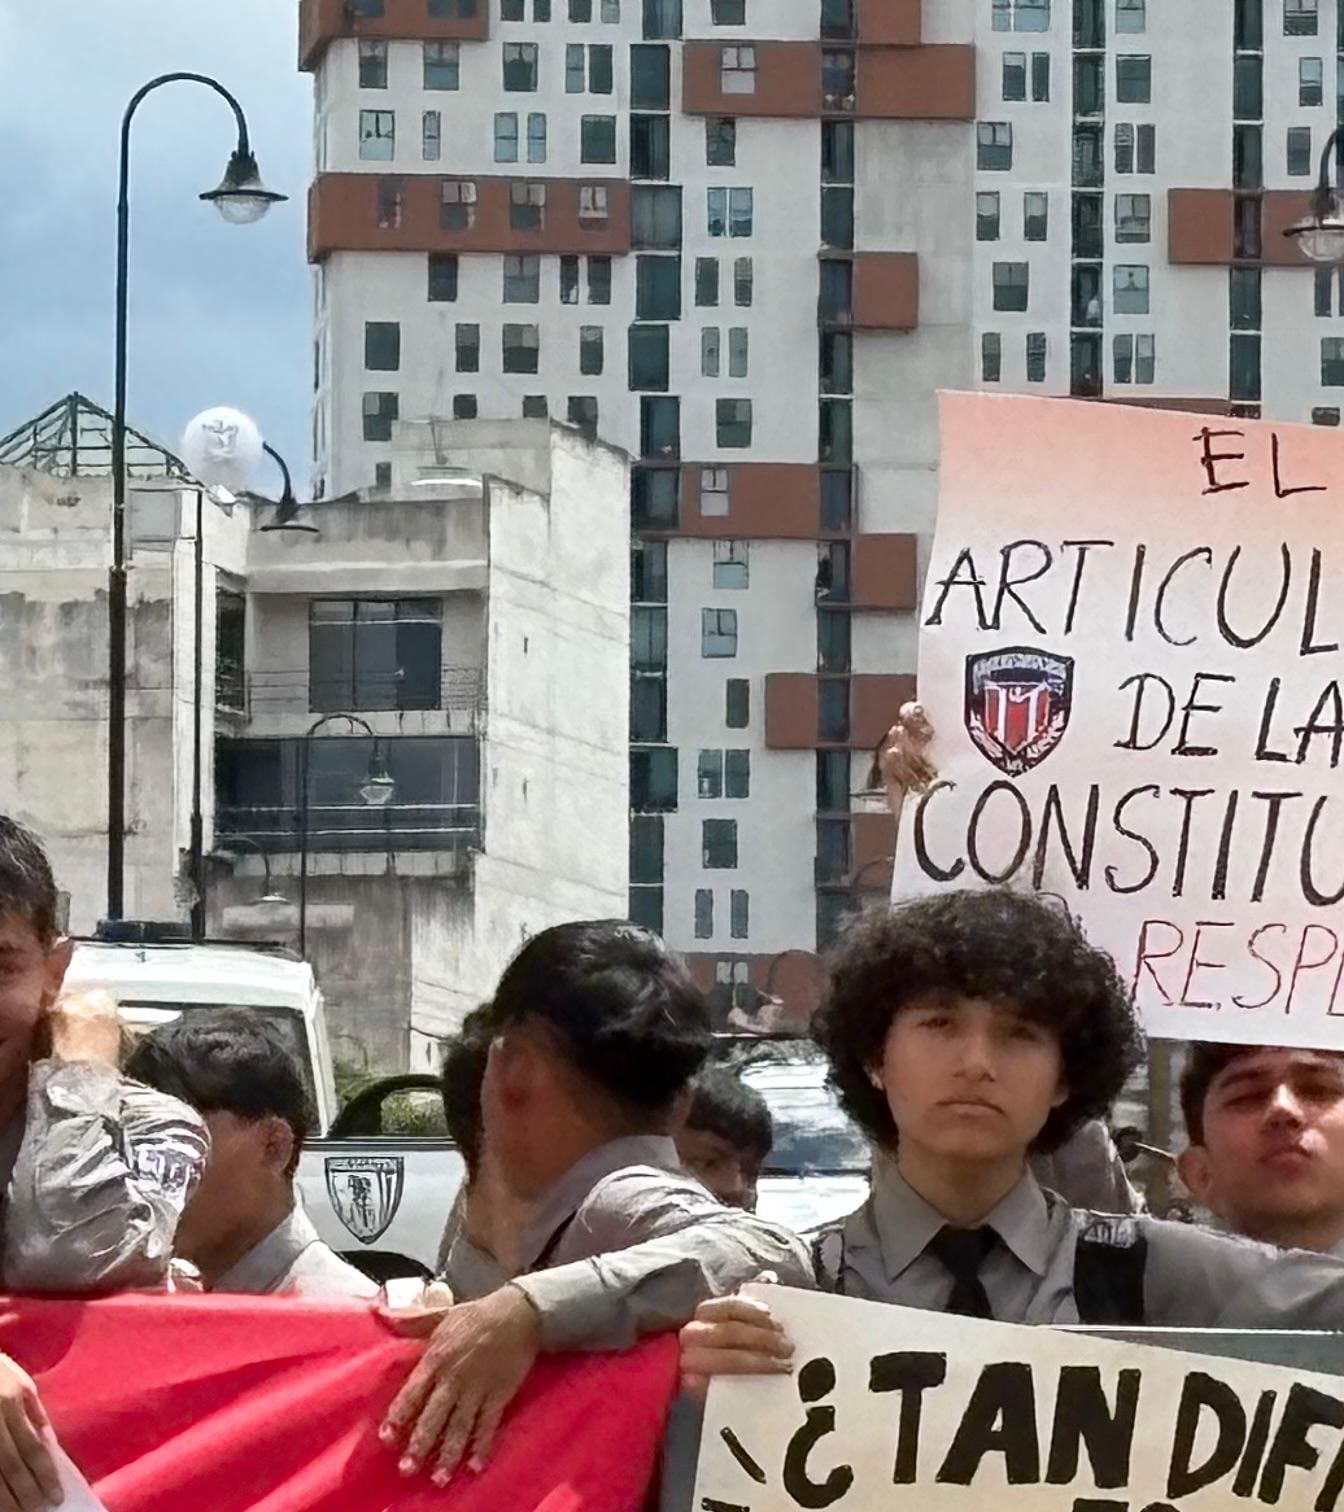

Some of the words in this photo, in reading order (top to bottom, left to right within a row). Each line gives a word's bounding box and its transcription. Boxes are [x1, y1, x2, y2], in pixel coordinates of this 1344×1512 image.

[1193, 426, 1328, 496] EL
[1113, 672, 1237, 757] DE
[783, 1351, 1142, 1509] ¿TAN
